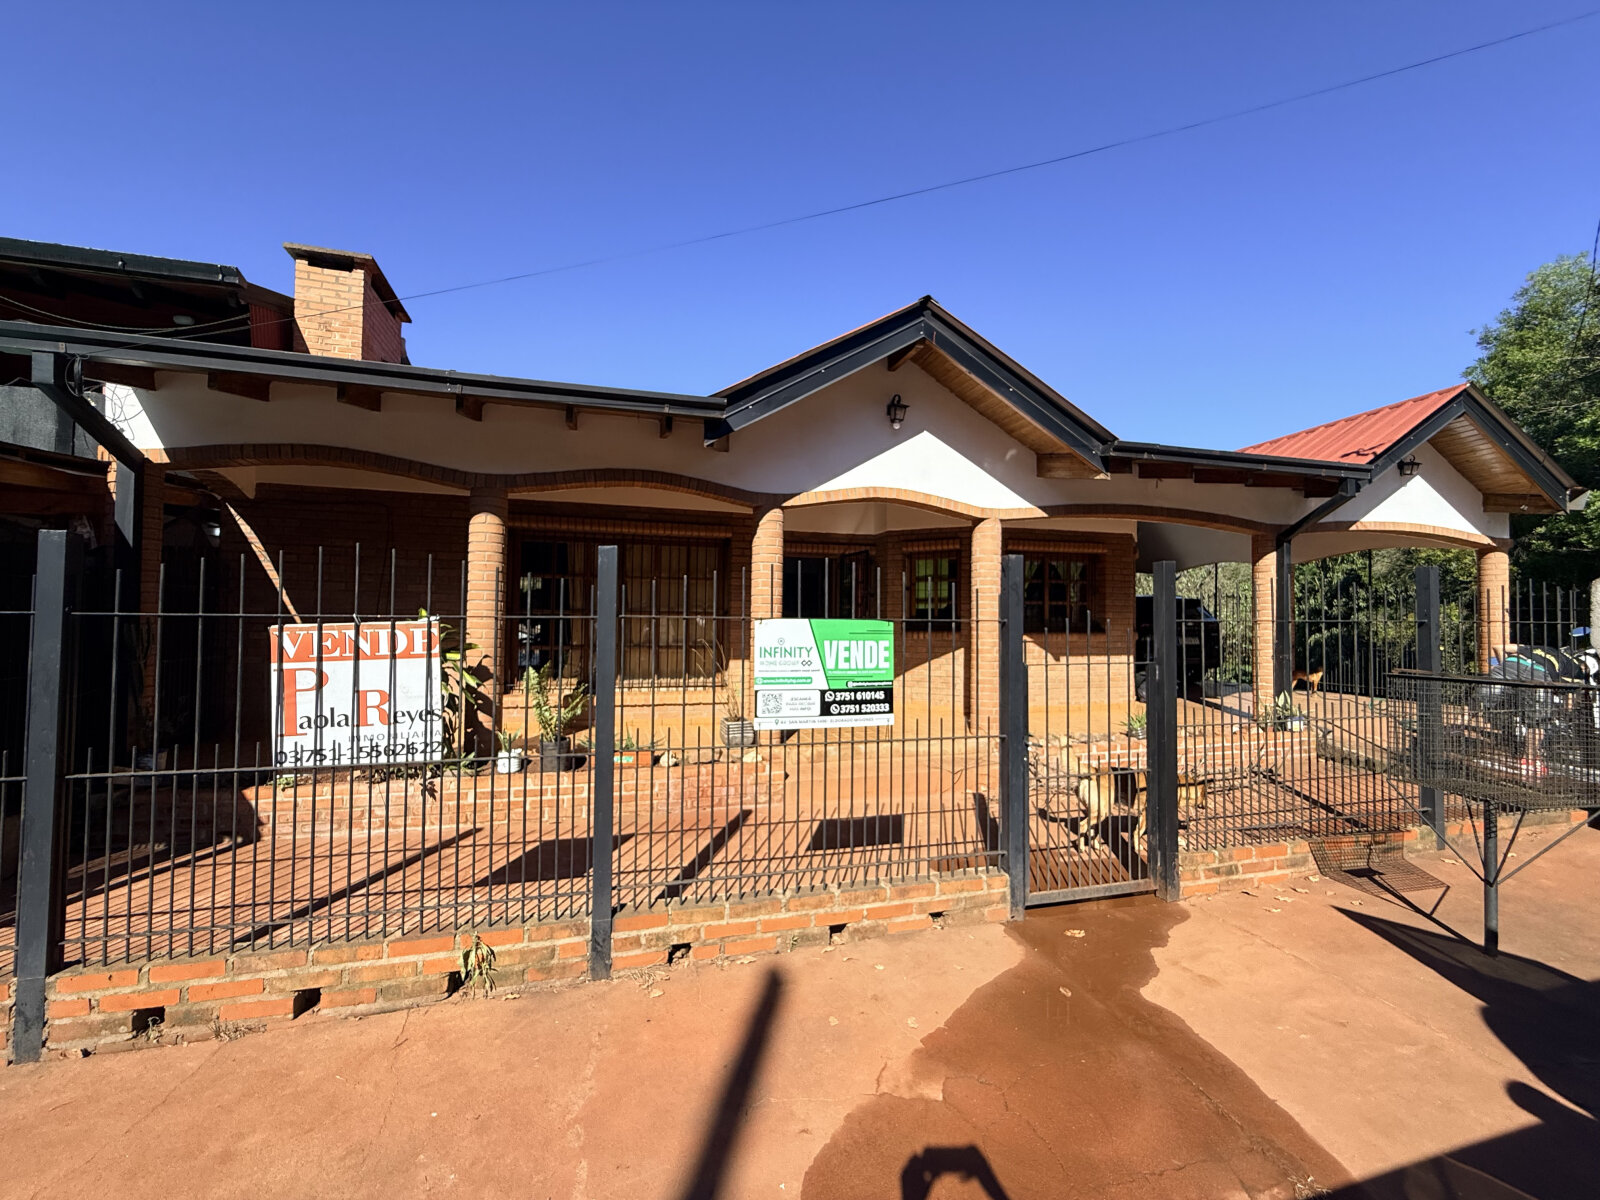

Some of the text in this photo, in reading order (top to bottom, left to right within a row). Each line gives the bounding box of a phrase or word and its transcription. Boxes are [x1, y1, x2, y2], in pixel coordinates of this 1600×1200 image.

[272, 627, 440, 660] VENDE
[759, 646, 813, 659] INFINITY
[823, 639, 890, 670] VENDE
[835, 690, 886, 701] 3751 610145
[840, 702, 890, 714] 3751 520333
